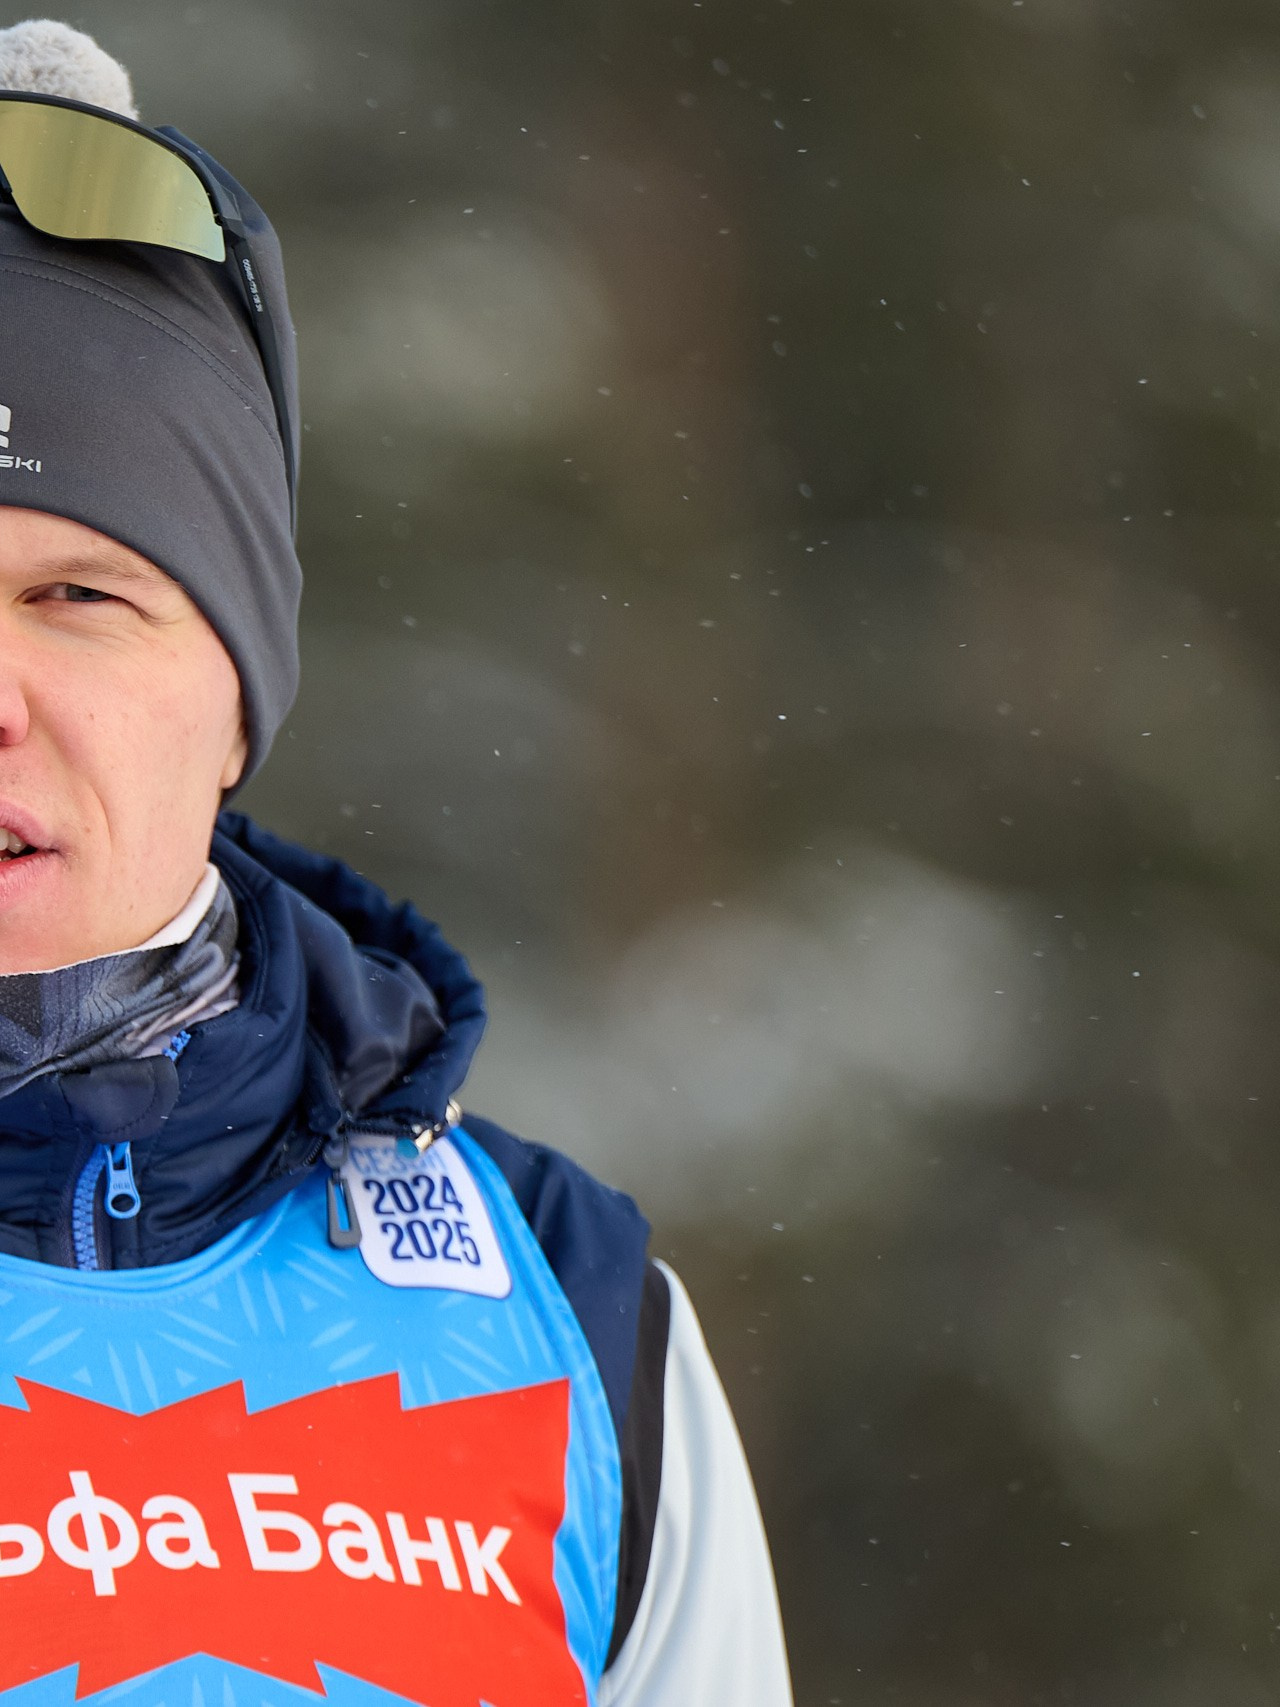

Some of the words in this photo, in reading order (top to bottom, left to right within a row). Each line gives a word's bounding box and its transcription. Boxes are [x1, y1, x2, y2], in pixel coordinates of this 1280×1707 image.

[363, 1174, 463, 1215] 2024
[381, 1218, 481, 1266] 2025
[227, 1472, 522, 1607] Банк
